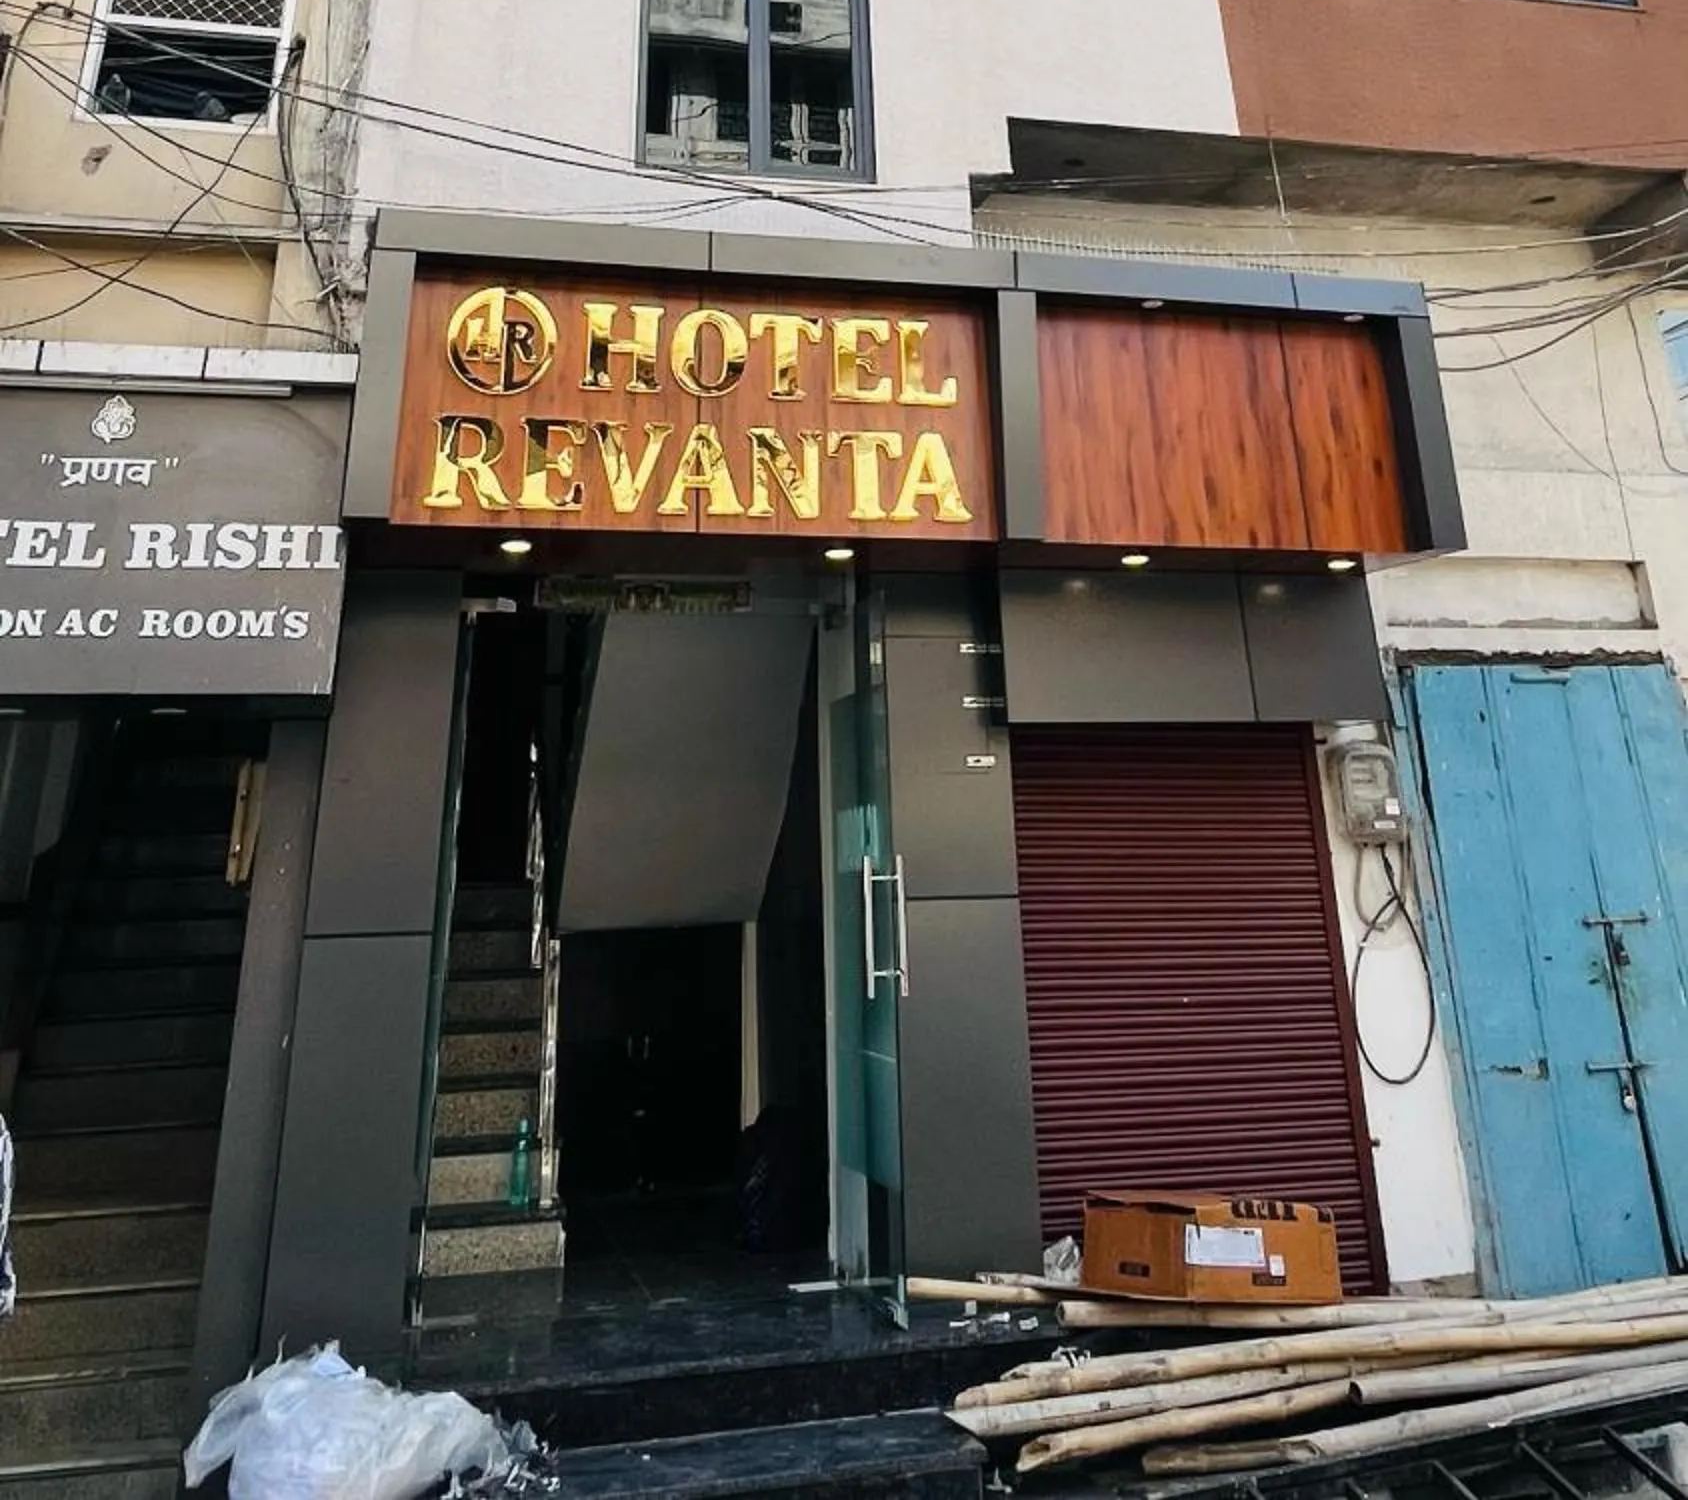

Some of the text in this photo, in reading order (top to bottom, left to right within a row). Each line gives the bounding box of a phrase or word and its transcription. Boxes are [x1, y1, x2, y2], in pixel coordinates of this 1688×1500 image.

[577, 303, 958, 406] HOTEL
[422, 414, 974, 524] REVANTA
[0, 518, 344, 570] EL RISHI
[56, 608, 119, 638] AC
[138, 605, 310, 639] ROOM'S
